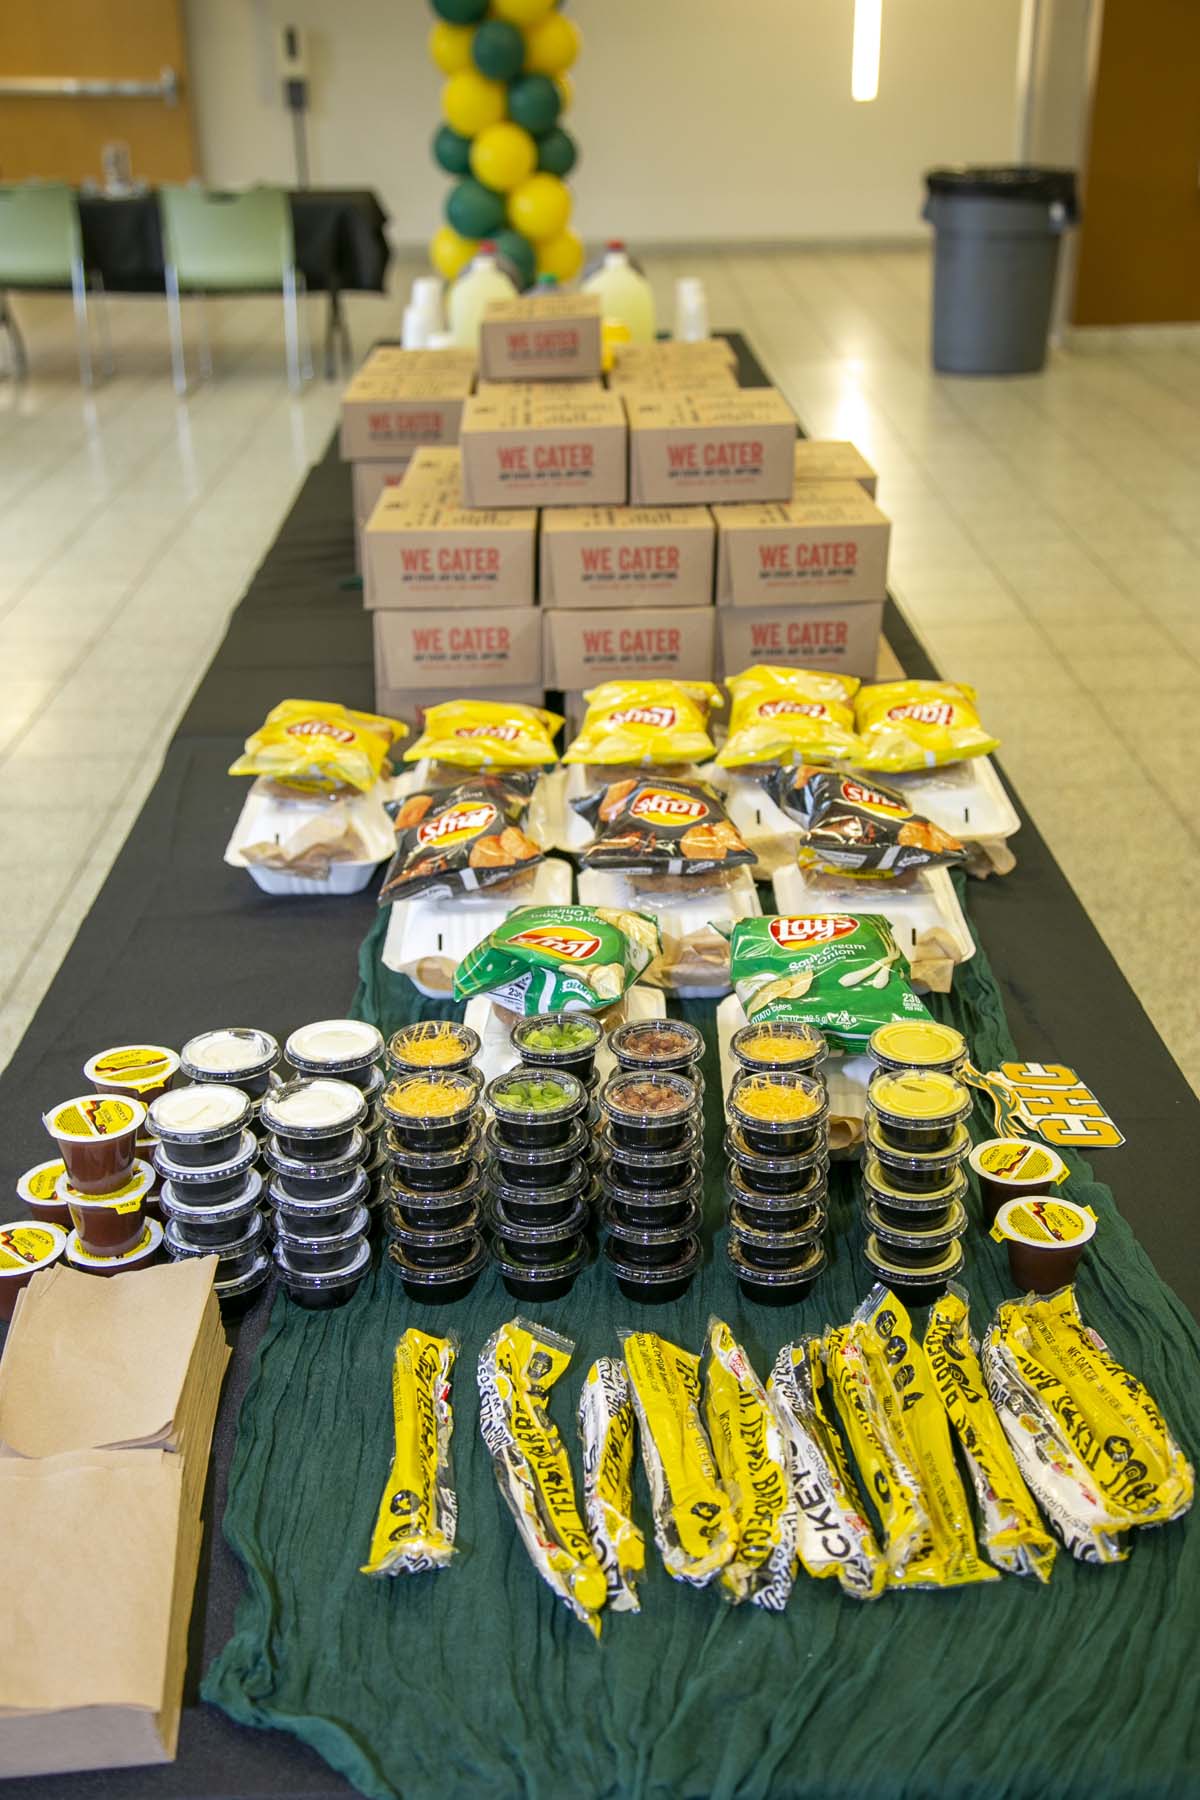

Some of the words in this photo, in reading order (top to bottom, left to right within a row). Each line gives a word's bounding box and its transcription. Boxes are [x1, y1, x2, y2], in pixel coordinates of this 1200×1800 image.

[507, 332, 529, 349] WE
[533, 330, 579, 347] CATER
[498, 446, 528, 470] WE
[533, 443, 594, 469] CATER
[667, 443, 697, 468] WE
[704, 441, 763, 466] CATER
[401, 548, 432, 572] WE
[437, 547, 501, 573] CATER
[581, 547, 612, 571] WE
[618, 545, 680, 571] CATER
[759, 544, 790, 569] WE
[796, 542, 857, 567] CATER
[412, 629, 442, 652] WE
[448, 627, 510, 652] CATER
[582, 630, 613, 653] WE
[619, 627, 681, 653] CATER
[752, 623, 781, 646] WE
[787, 621, 848, 646] CATER
